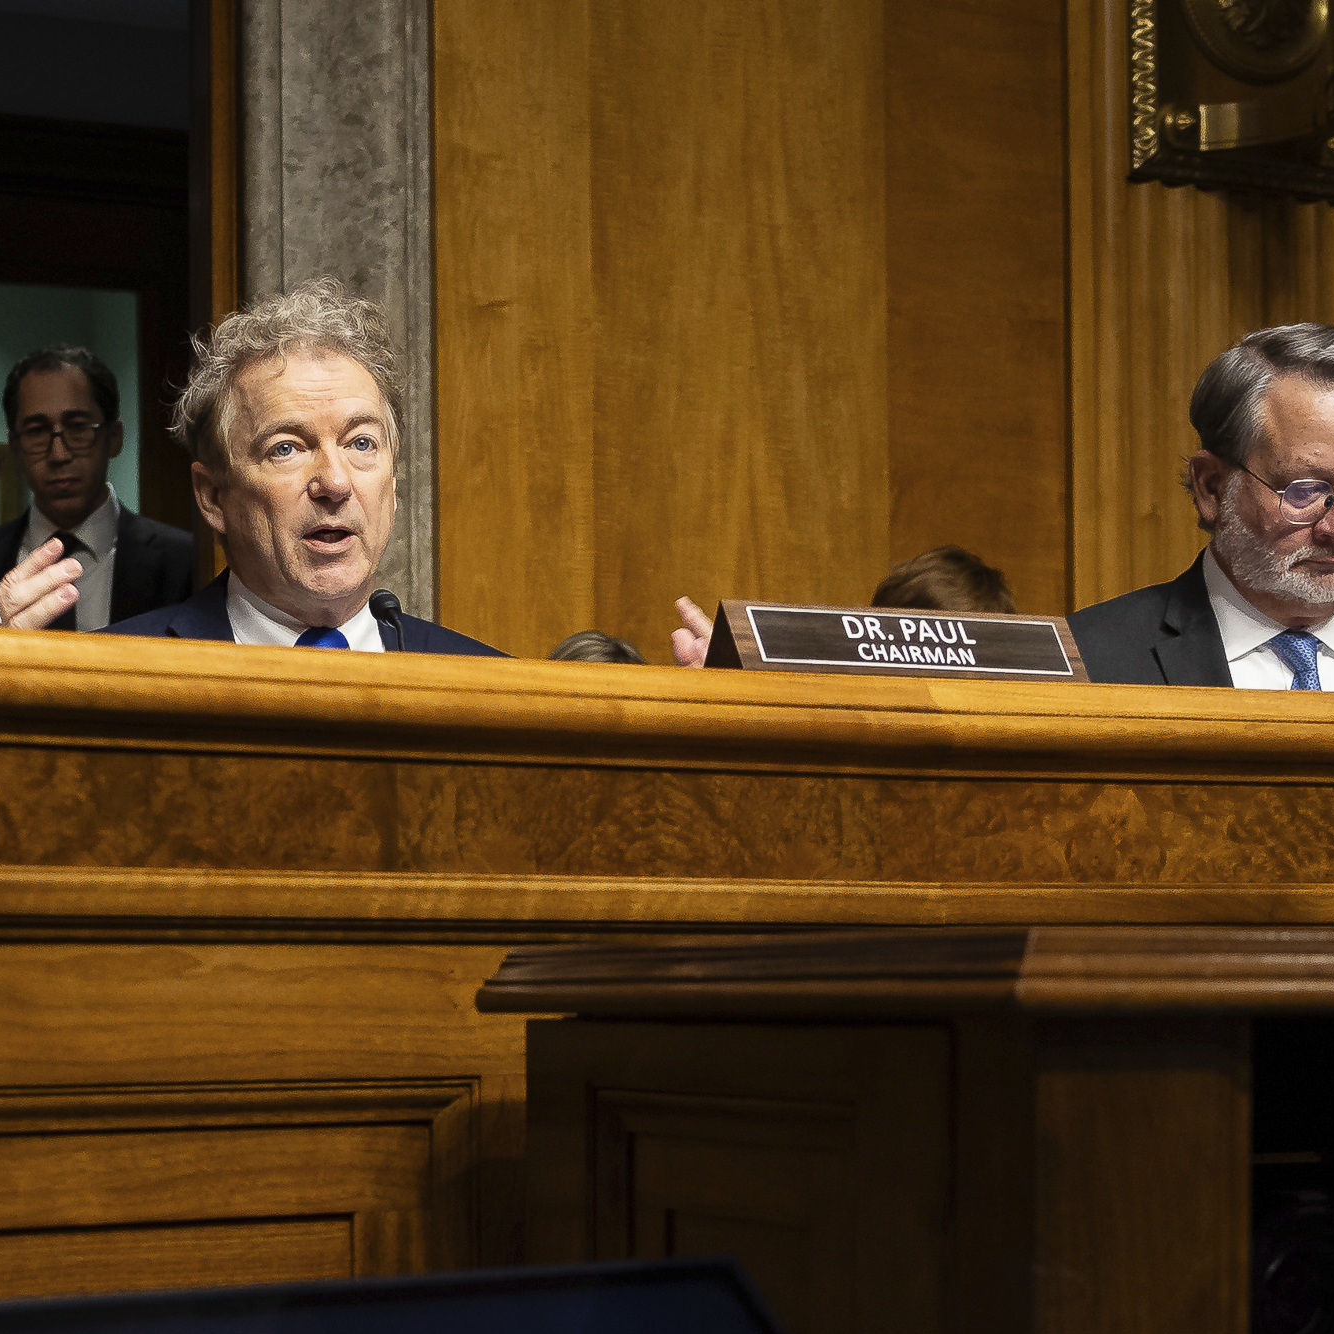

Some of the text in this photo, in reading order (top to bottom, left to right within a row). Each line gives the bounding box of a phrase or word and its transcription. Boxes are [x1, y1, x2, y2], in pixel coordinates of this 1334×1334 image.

[842, 615, 977, 645] DR. PAUL
[857, 642, 976, 666] CHAIRMAN
